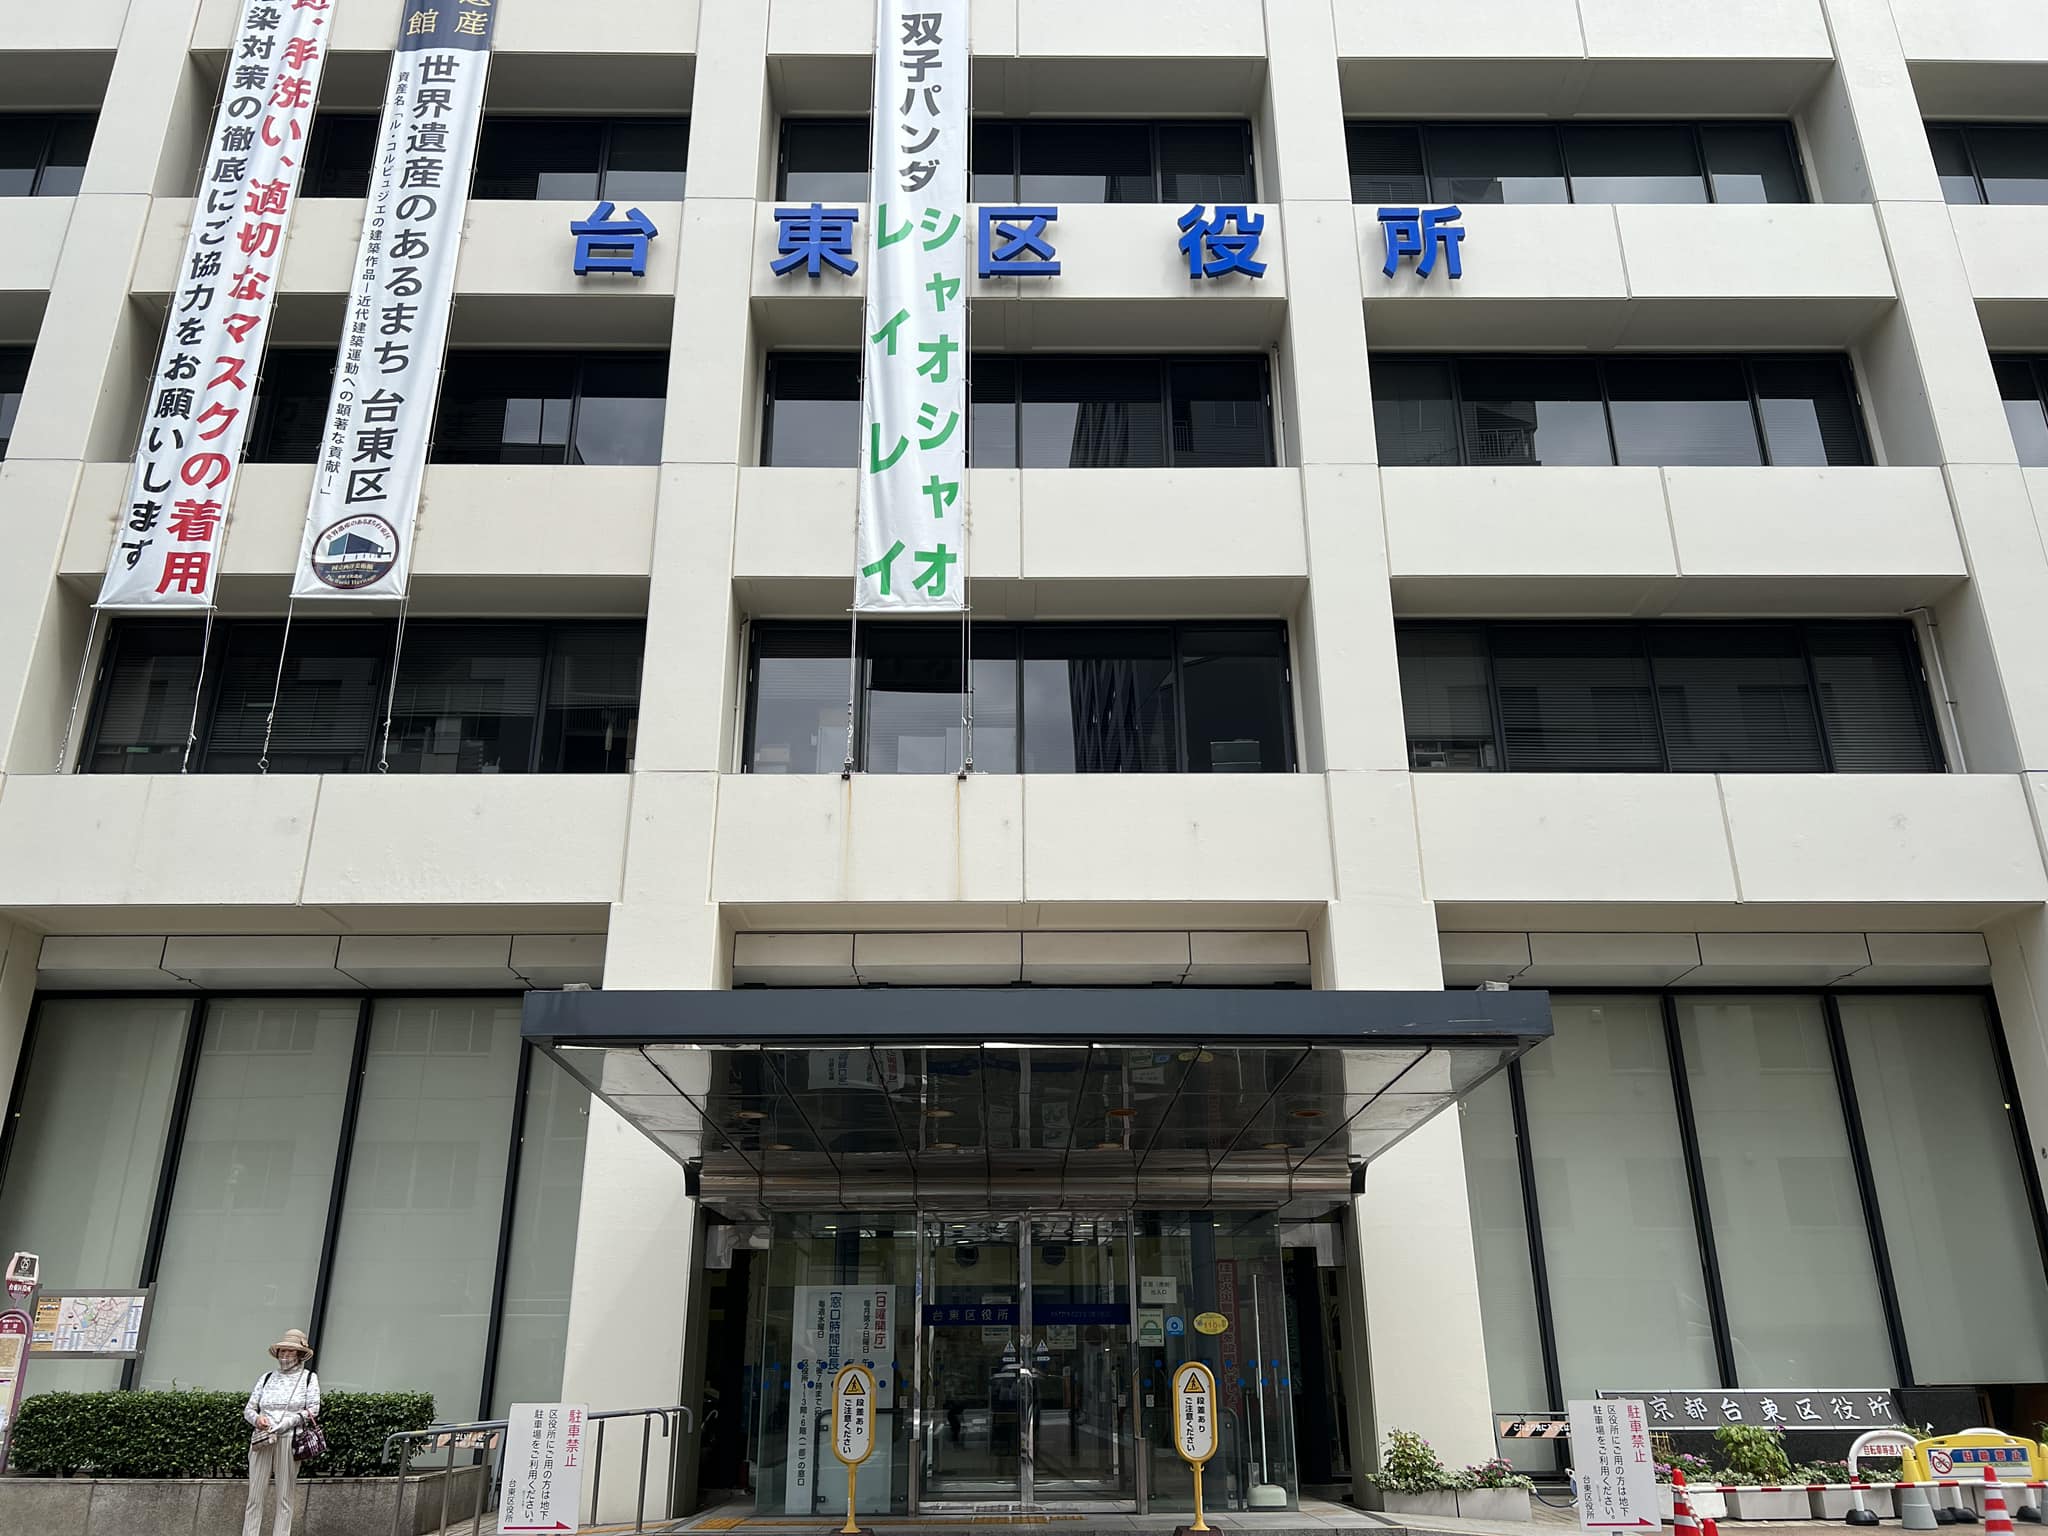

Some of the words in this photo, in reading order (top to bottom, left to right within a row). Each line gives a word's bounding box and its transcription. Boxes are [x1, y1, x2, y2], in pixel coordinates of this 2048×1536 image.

[406, 8, 440, 36] 館
[454, 0, 492, 36] 産
[900, 12, 943, 193] 双子パンダ
[374, 54, 461, 375] 世界遺産のあるまち
[570, 201, 1465, 280] 台東区役所
[120, 0, 282, 571] 染対策の徹底にご協力をお願いします
[862, 203, 914, 596] レイレイ
[911, 207, 962, 597] シャオシャオ
[345, 388, 405, 504] 台東区
[932, 1309, 1009, 1321] 台東区役所
[564, 1409, 582, 1467] 駐車禁止
[842, 1398, 853, 1454] ご注意ください
[855, 1398, 865, 1435] 段差あり
[1185, 1397, 1195, 1452] ご注意ください
[1197, 1396, 1206, 1433] 段差あり
[1614, 1395, 1893, 1423] 京都台東区役所
[1627, 1404, 1647, 1463] 駐車禁止
[524, 1409, 544, 1523] 駐車場をご利用ください。
[539, 1409, 558, 1521] 区役所にご用の方は地下
[1593, 1404, 1616, 1520] 駐車場をご利用ください。
[1607, 1404, 1630, 1517] 区役所にご用の方は地下
[1962, 1450, 2022, 1462] 駐輪禁止
[504, 1479, 517, 1523] 台東区役所
[1583, 1474, 1595, 1519] 台東区役所
